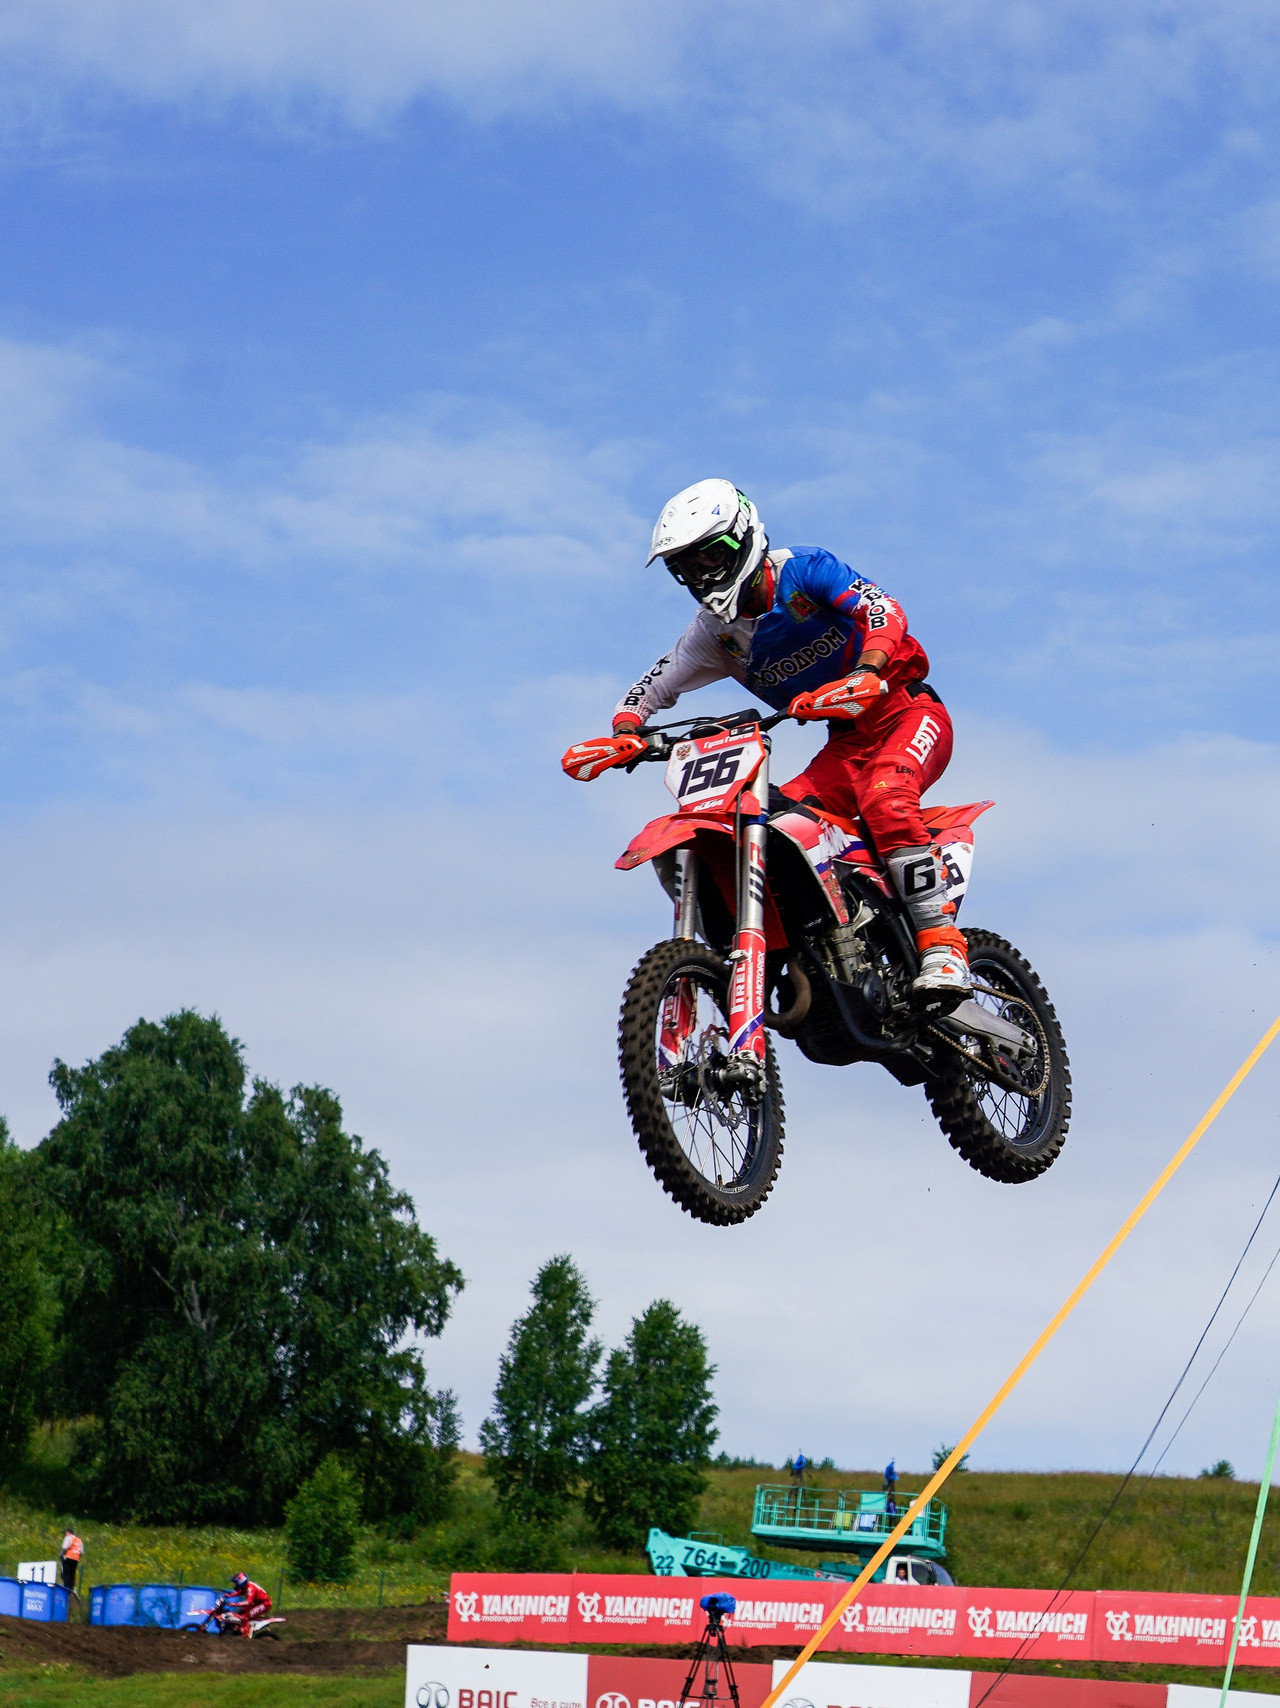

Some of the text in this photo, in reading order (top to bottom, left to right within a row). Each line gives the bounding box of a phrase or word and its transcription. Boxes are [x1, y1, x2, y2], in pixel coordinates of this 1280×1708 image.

[678, 747, 745, 799] 156
[655, 1555, 674, 1569] 22
[31, 1566, 45, 1582] 11
[481, 1595, 570, 1616] YAKHNICH
[604, 1596, 694, 1618] YAKHNICH
[733, 1601, 824, 1623] YAKHNICH
[866, 1606, 957, 1629] YAKHNICH
[996, 1610, 1088, 1634] YAKHNICH
[1134, 1614, 1227, 1638] YAKHNICH
[459, 1689, 518, 1708] BAIC
